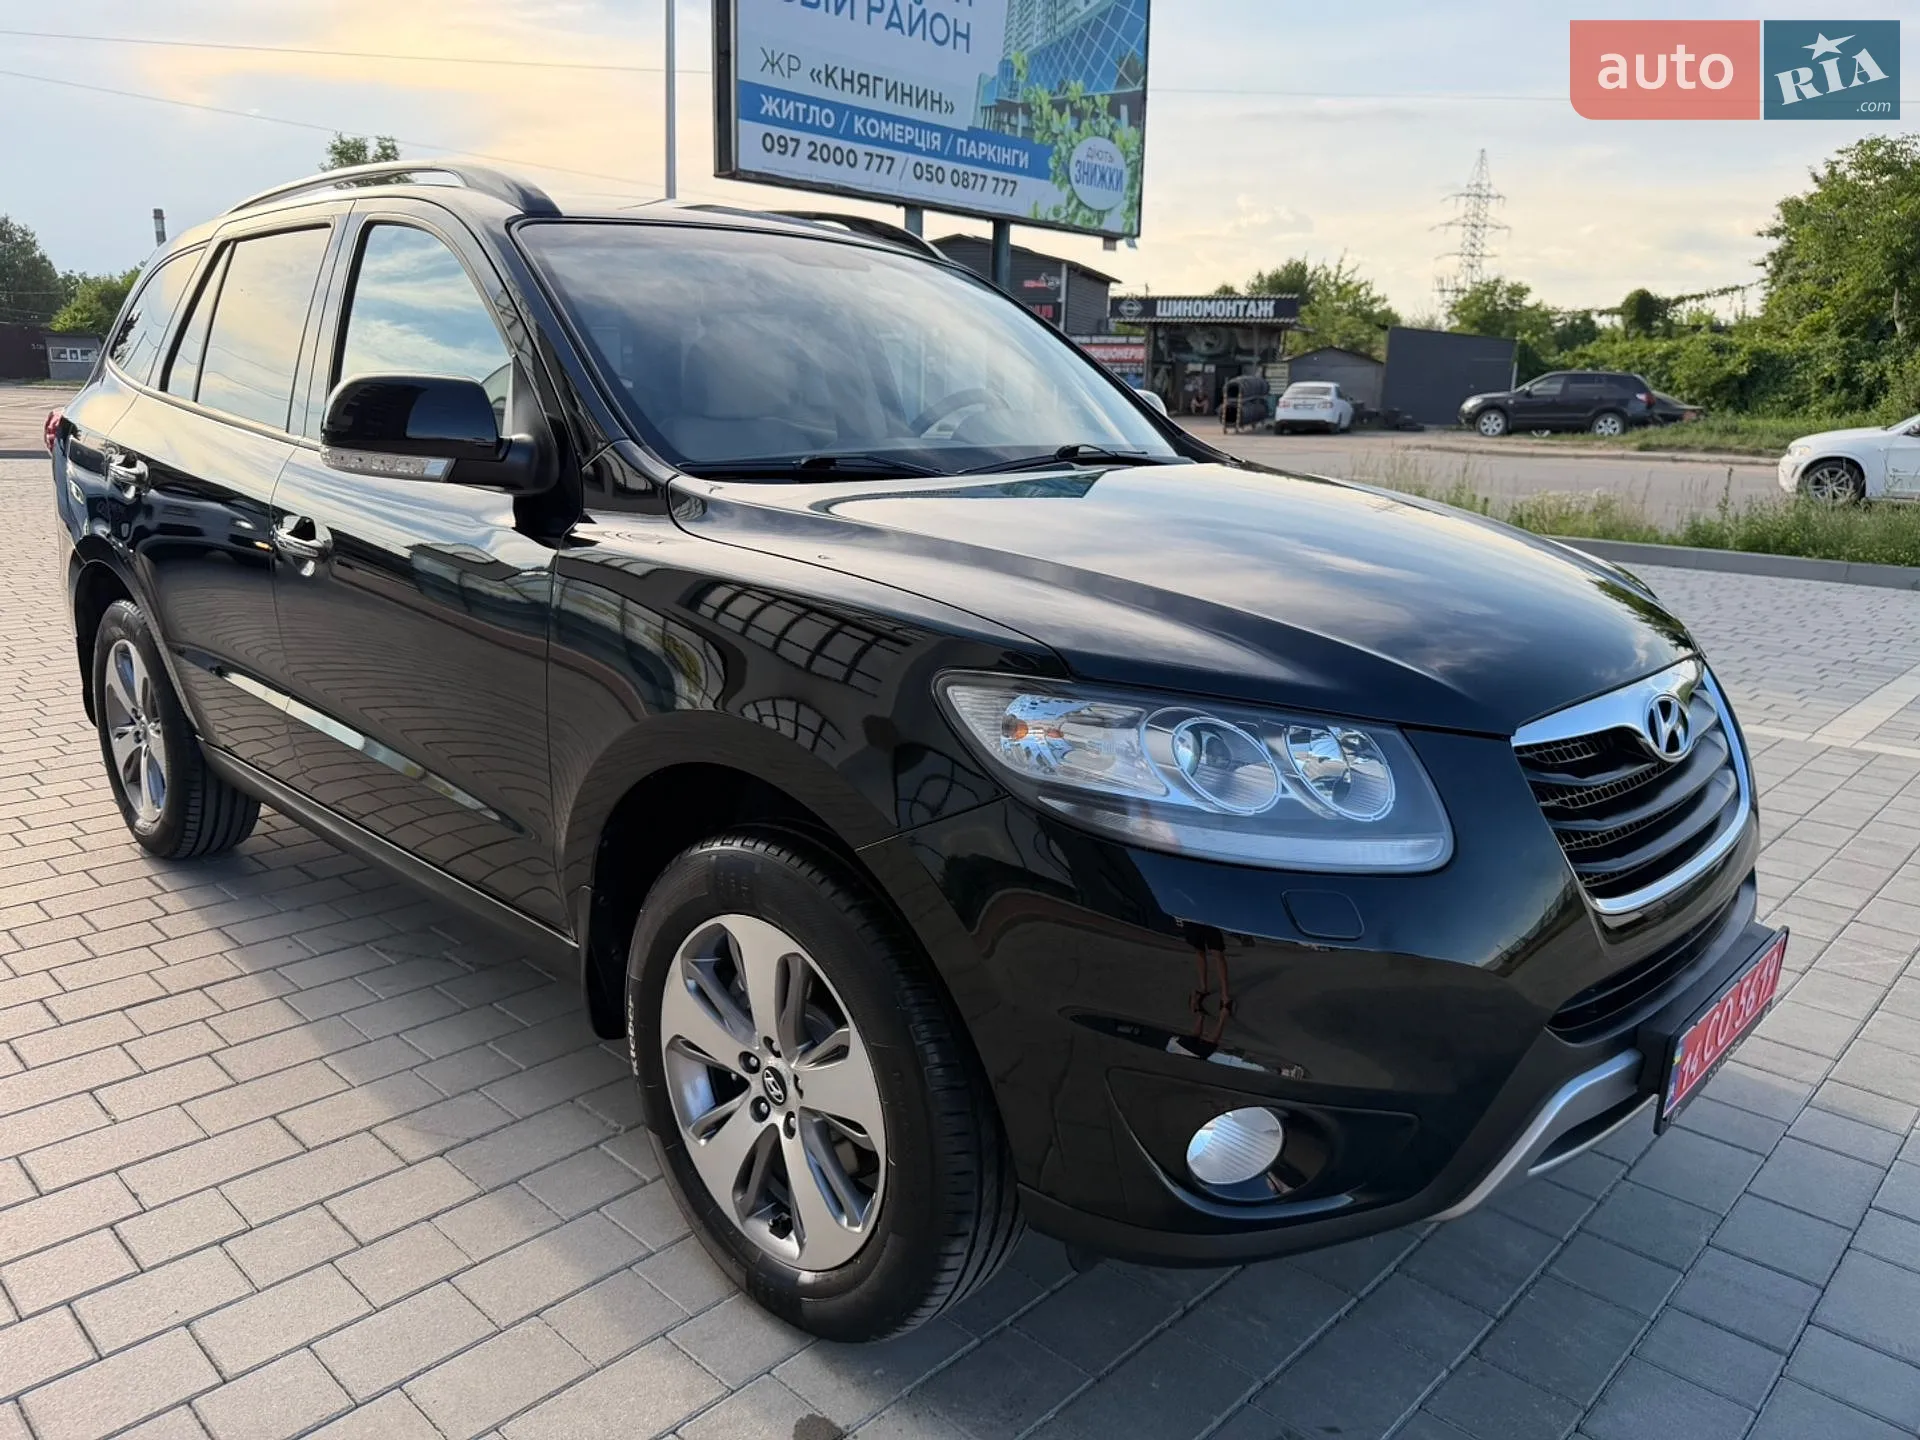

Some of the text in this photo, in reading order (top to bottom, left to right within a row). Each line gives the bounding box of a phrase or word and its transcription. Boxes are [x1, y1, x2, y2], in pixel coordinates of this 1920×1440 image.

[866, 0, 970, 53] РАЙОН
[760, 47, 955, 115] ЖР «КНЯГИНИН»
[760, 93, 835, 129] ЖИТЛО
[854, 115, 941, 152] КОМЕРЦІЯ
[956, 138, 1029, 169] ПАРКІНГИ
[762, 132, 800, 158] 097
[807, 141, 857, 169] 2000
[864, 152, 895, 175] 777
[913, 161, 945, 184] 050
[951, 168, 988, 193] 0877
[993, 175, 1017, 197] 777
[1075, 159, 1123, 192] ЗНИЖКИ
[1156, 300, 1275, 318] ШИНОМОНТАЖ
[1704, 999, 1733, 1061] CO
